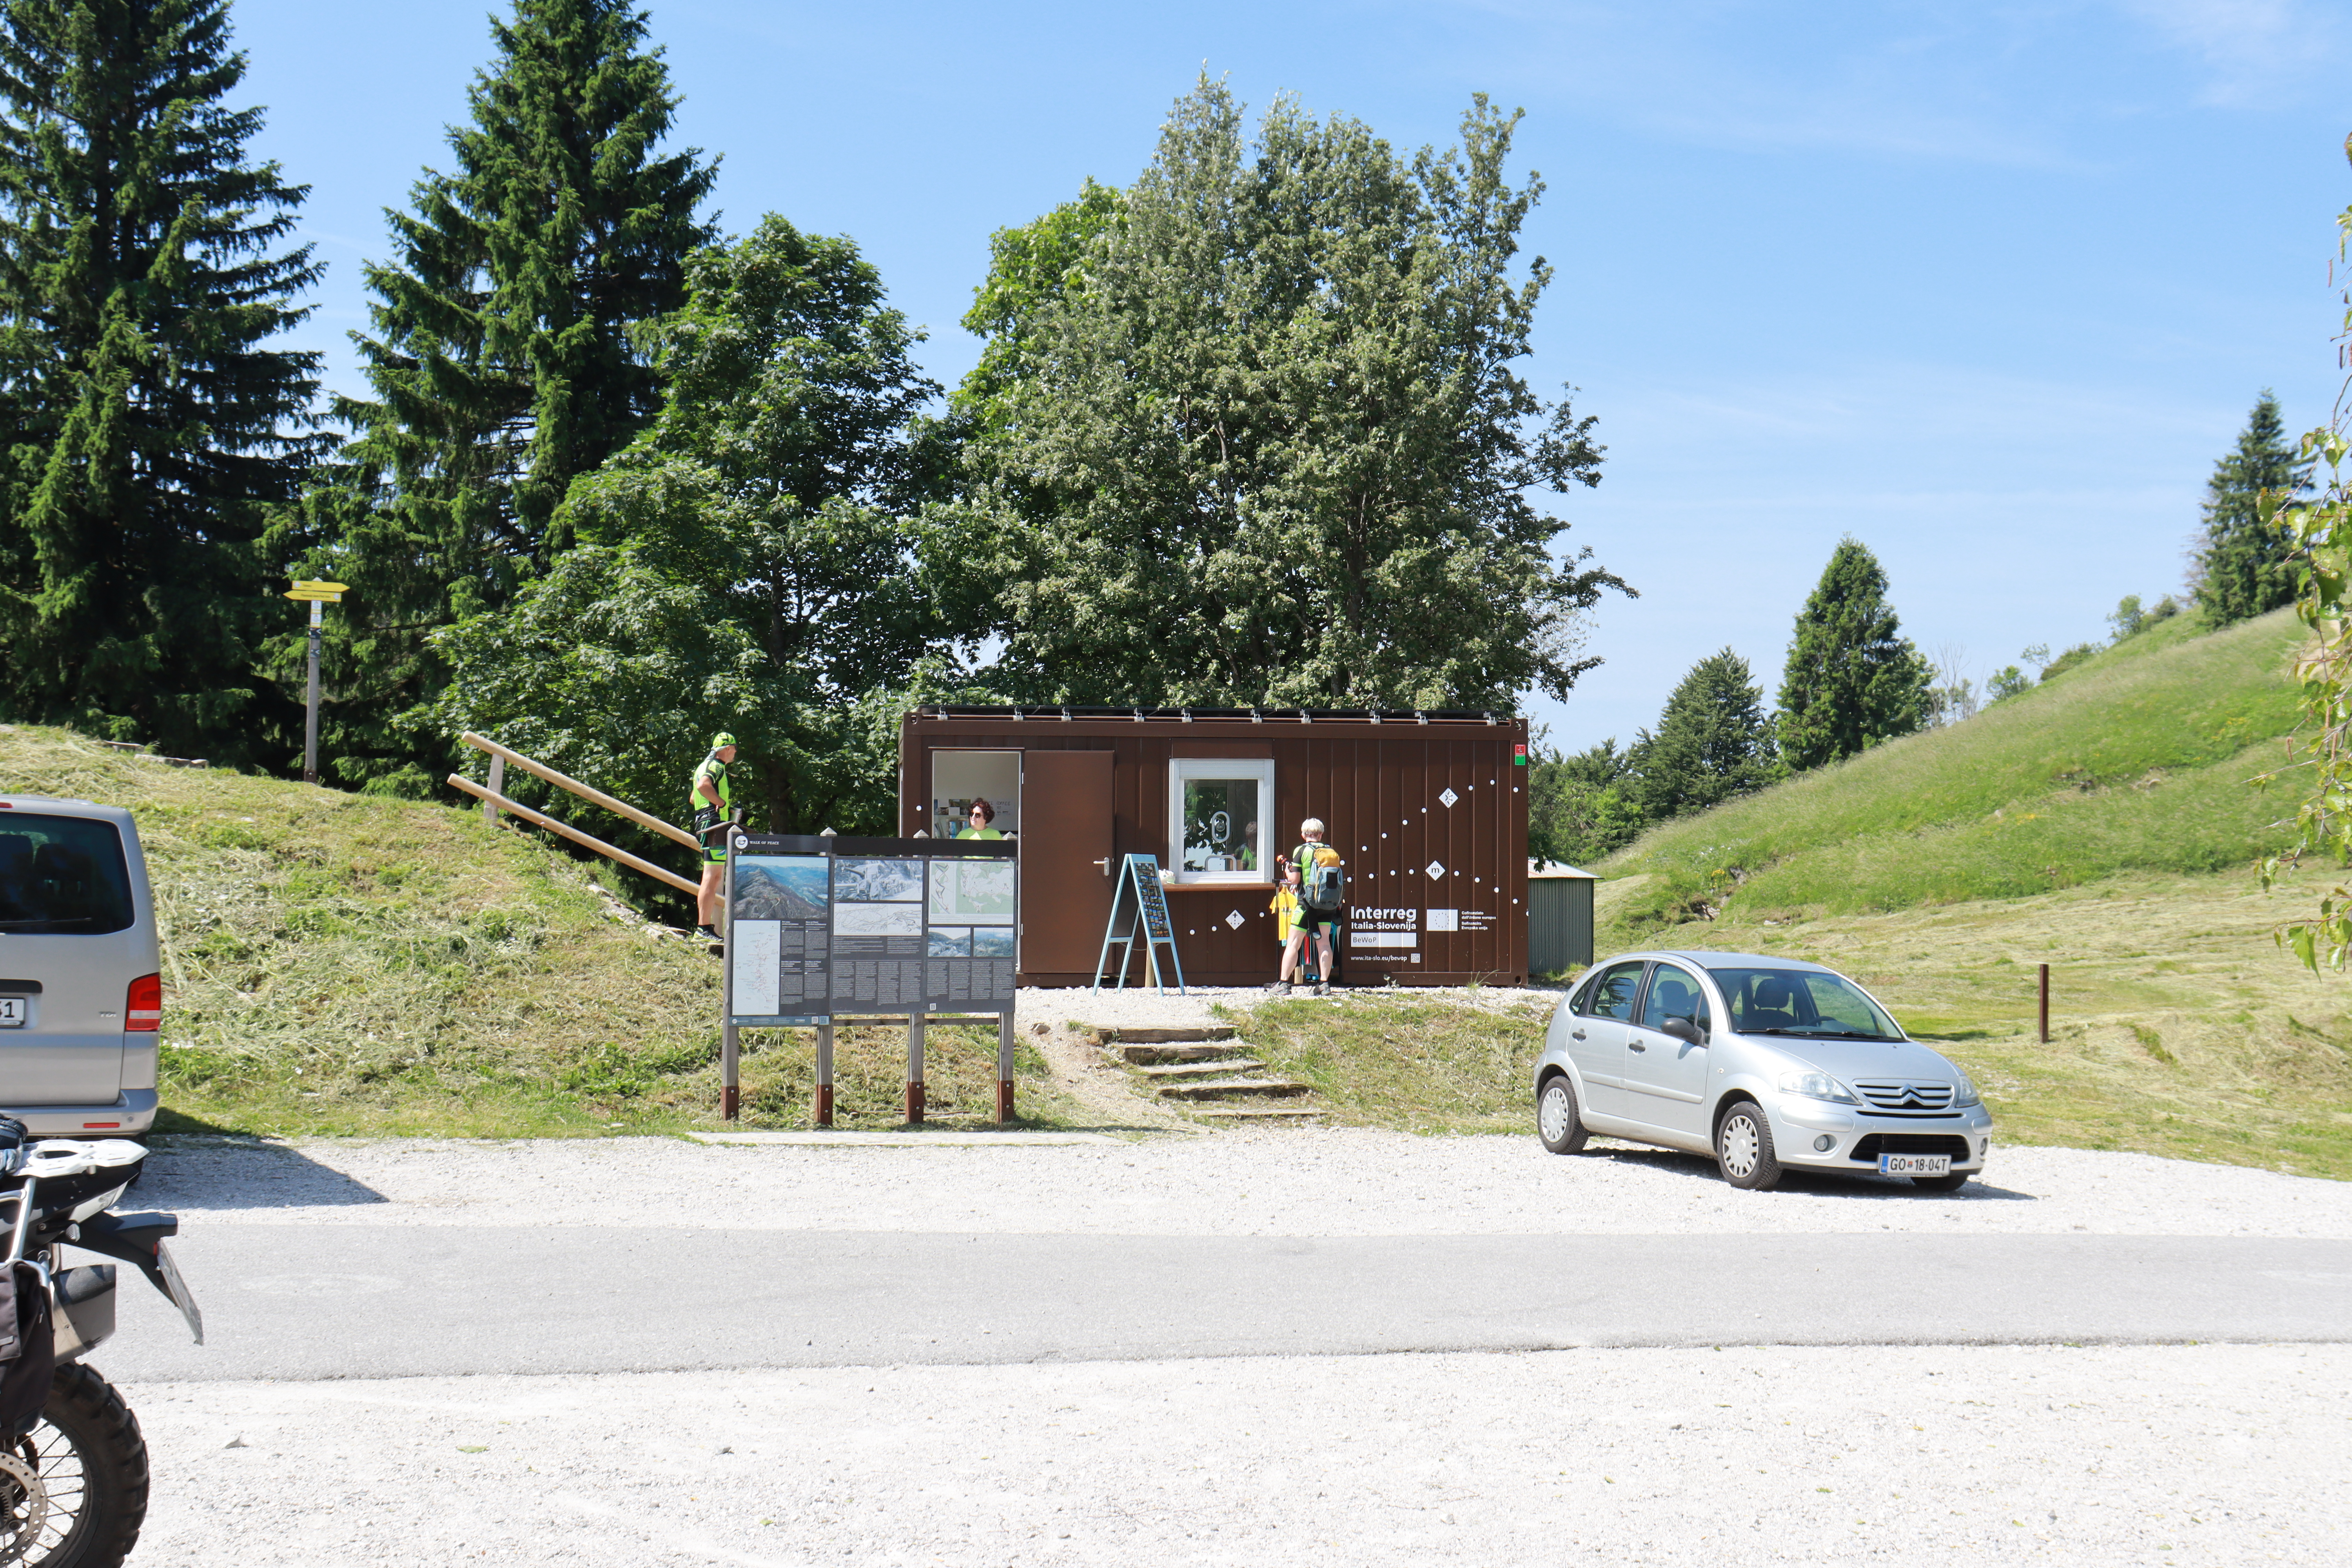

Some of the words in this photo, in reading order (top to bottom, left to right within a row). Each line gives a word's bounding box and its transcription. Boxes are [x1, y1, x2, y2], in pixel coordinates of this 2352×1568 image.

[1351, 906, 1416, 922] Interreg
[1351, 921, 1416, 931] Italia-Slovenija
[1890, 1158, 1906, 1171] GO
[1915, 1158, 1947, 1171] 18-04T
